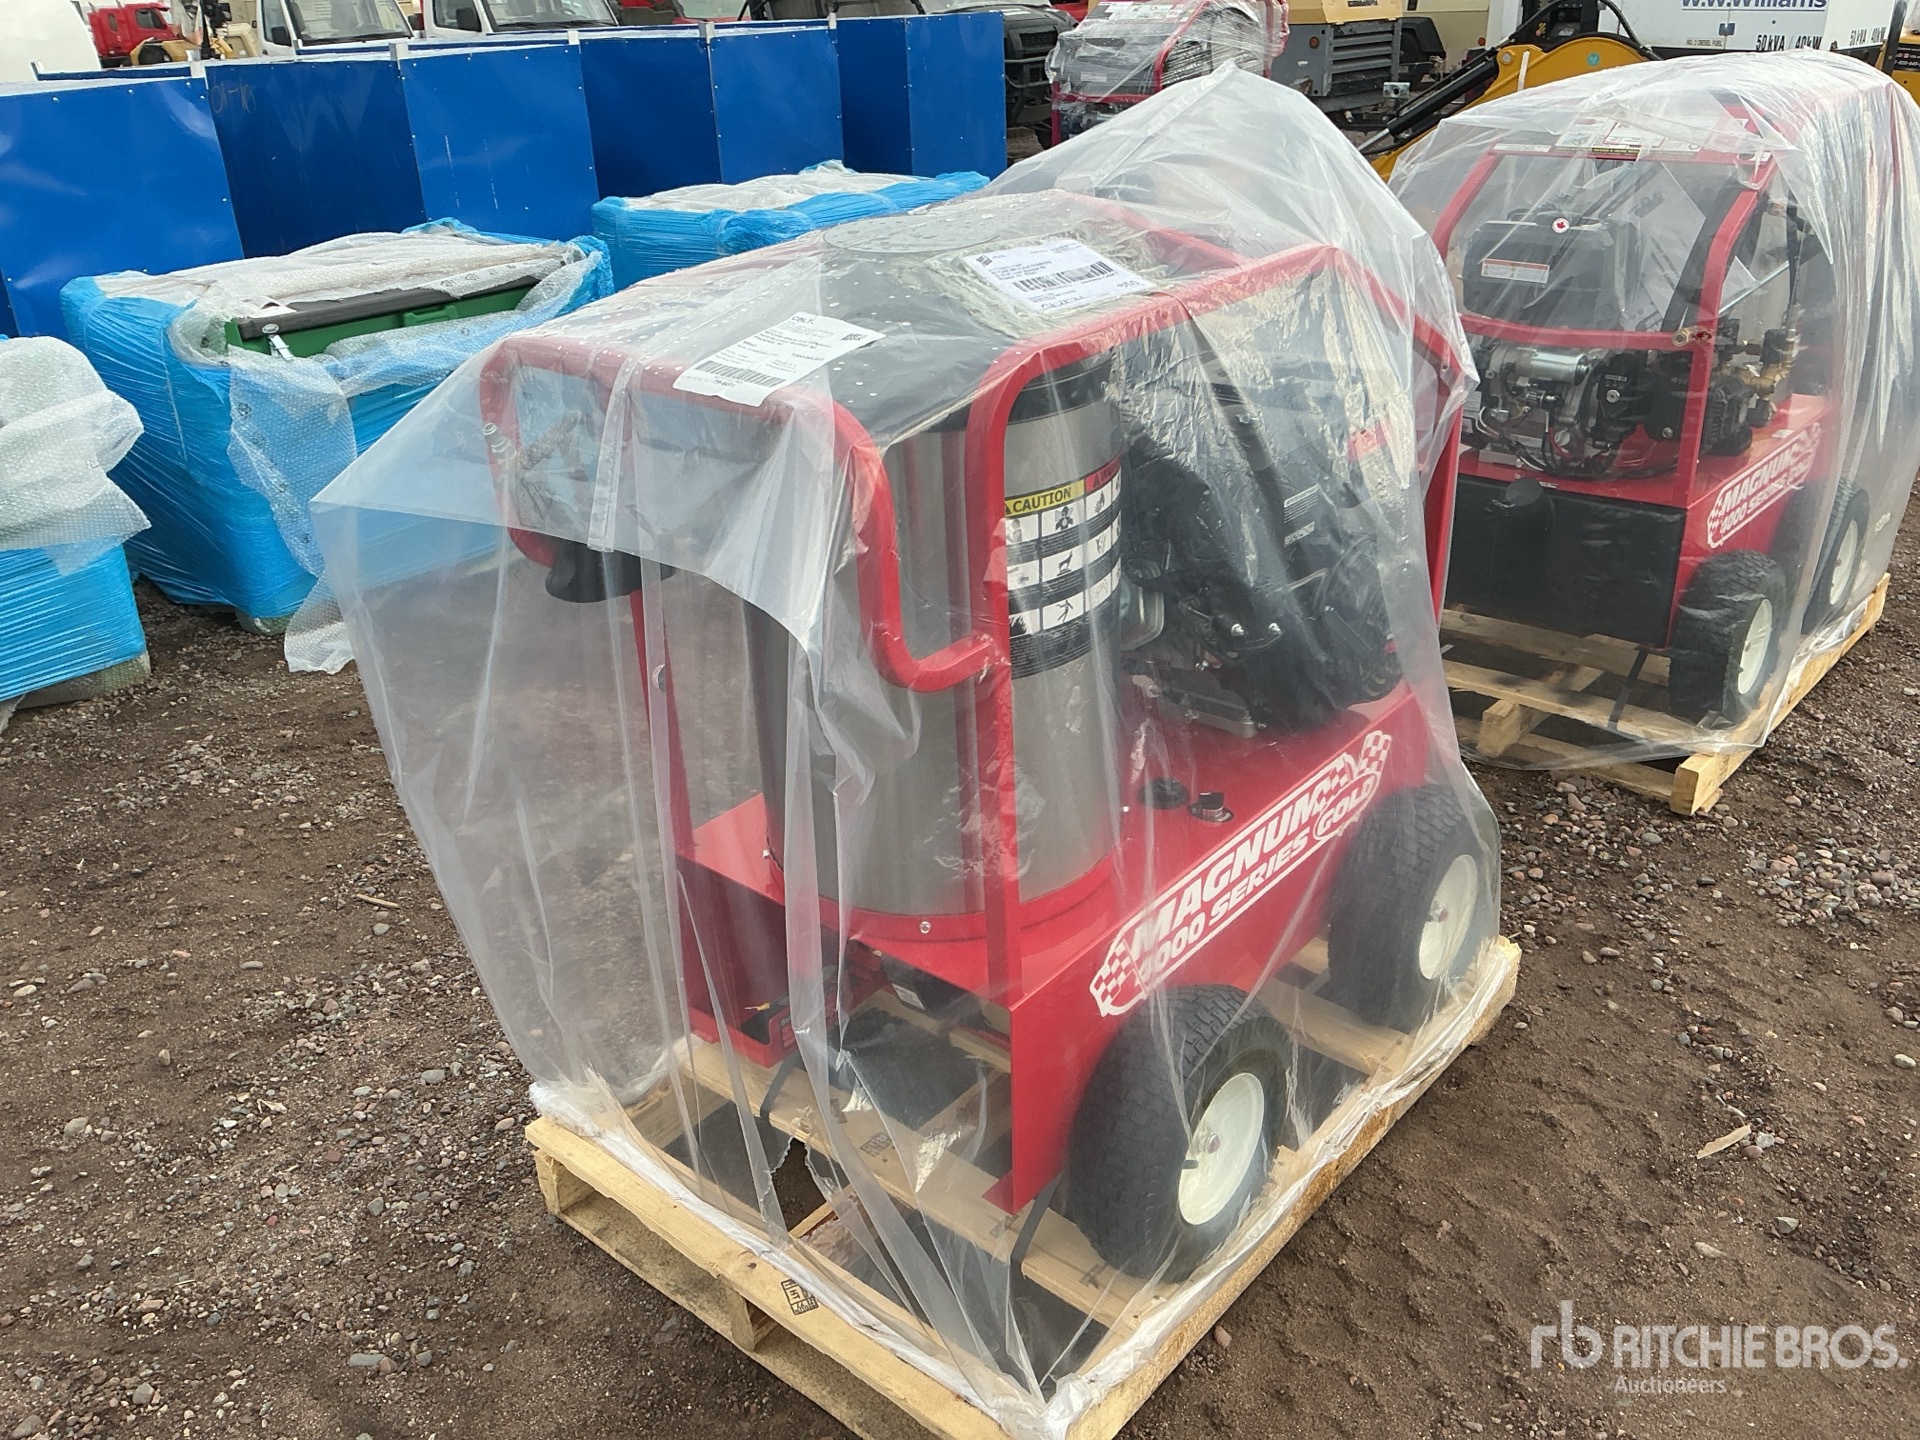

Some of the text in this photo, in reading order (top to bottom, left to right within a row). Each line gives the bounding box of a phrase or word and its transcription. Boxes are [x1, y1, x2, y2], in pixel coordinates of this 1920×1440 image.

[1012, 487, 1072, 513] CAUTION
[1129, 770, 1345, 960] MAGNUM
[1208, 826, 1310, 927] SERIES
[1317, 777, 1373, 834] GOLD
